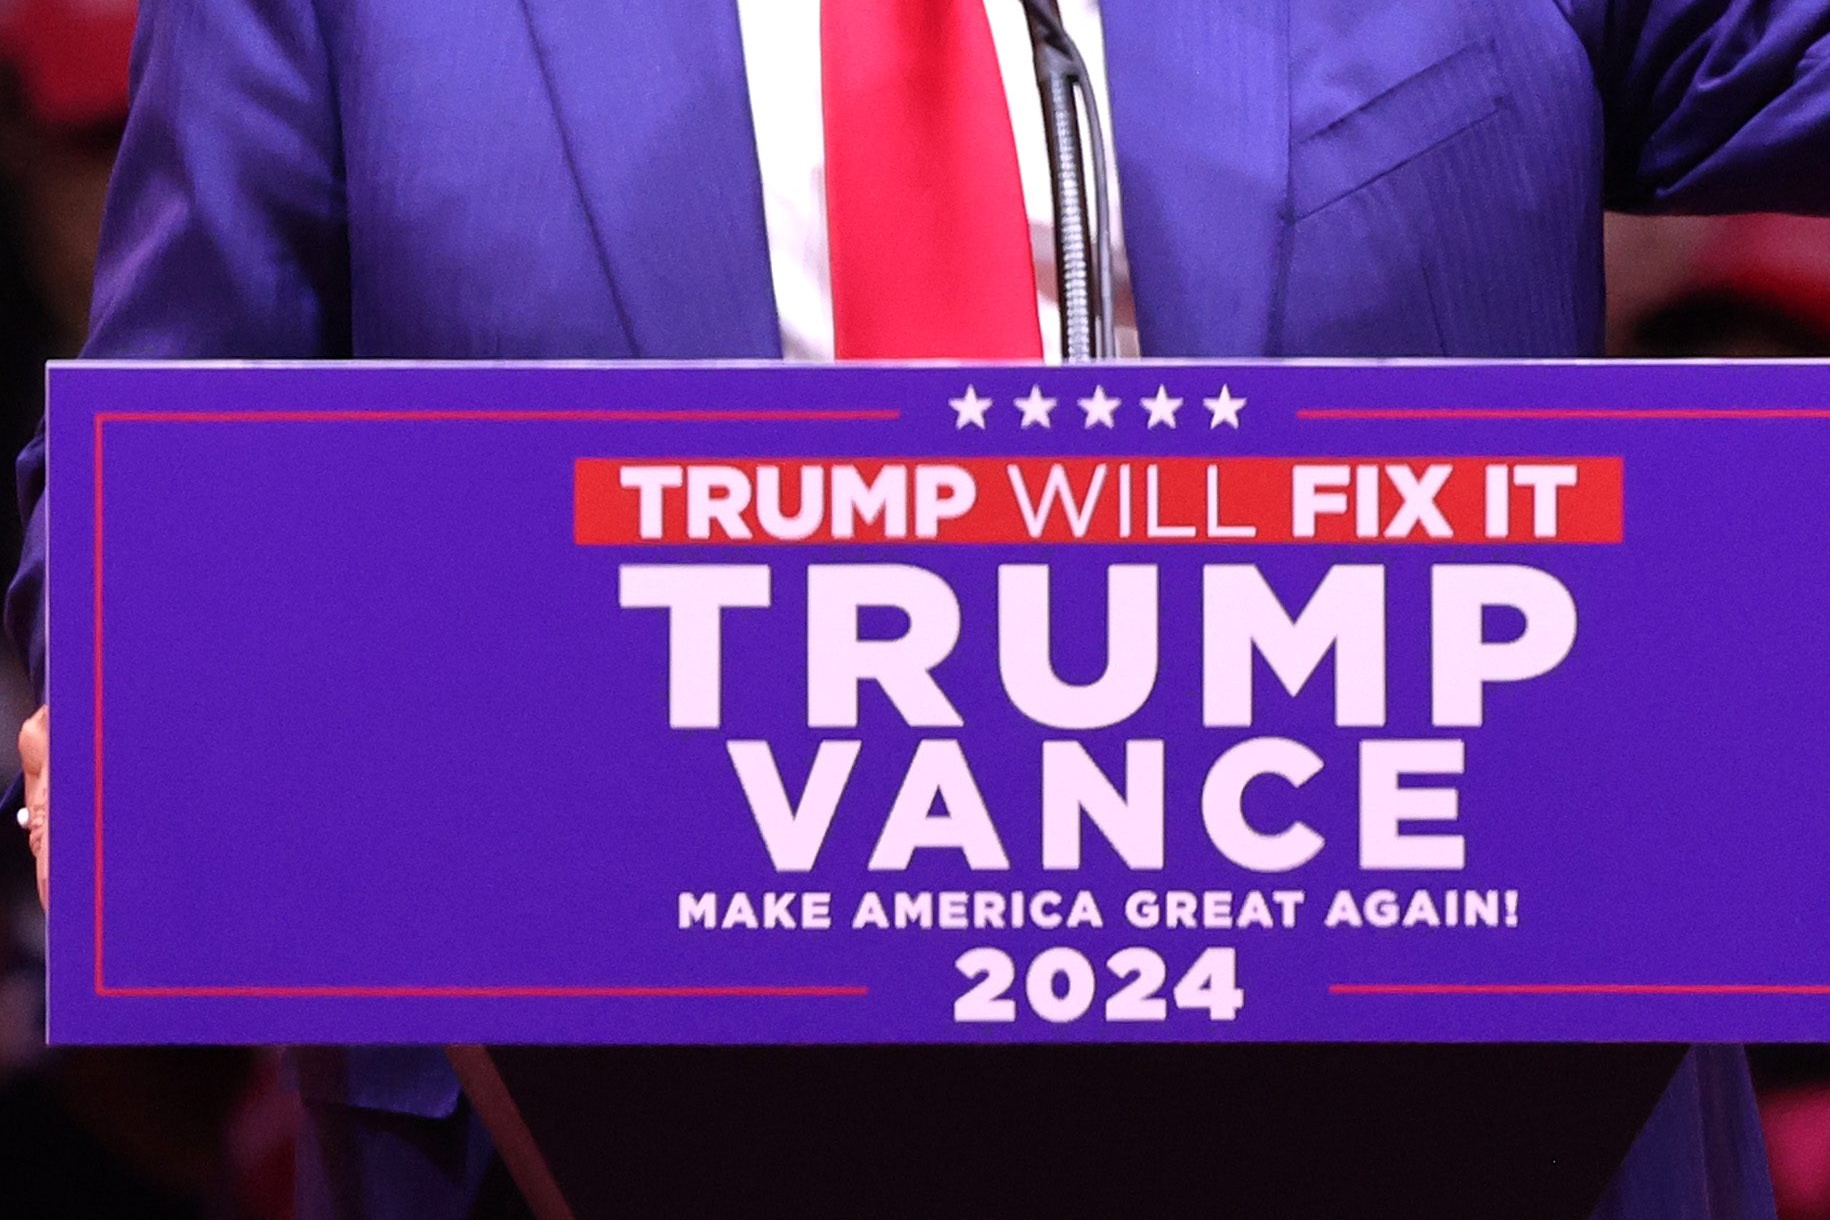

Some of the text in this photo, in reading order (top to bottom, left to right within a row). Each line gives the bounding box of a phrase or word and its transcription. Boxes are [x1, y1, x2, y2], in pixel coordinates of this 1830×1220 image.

[619, 464, 1578, 541] TRUMP WILL FIX IT
[618, 563, 1578, 730] TRUMP
[726, 736, 1466, 873] VANCE
[678, 890, 1518, 930] MAKE AMERICA GREAT AGAIN!
[953, 946, 1244, 1023] 2024
